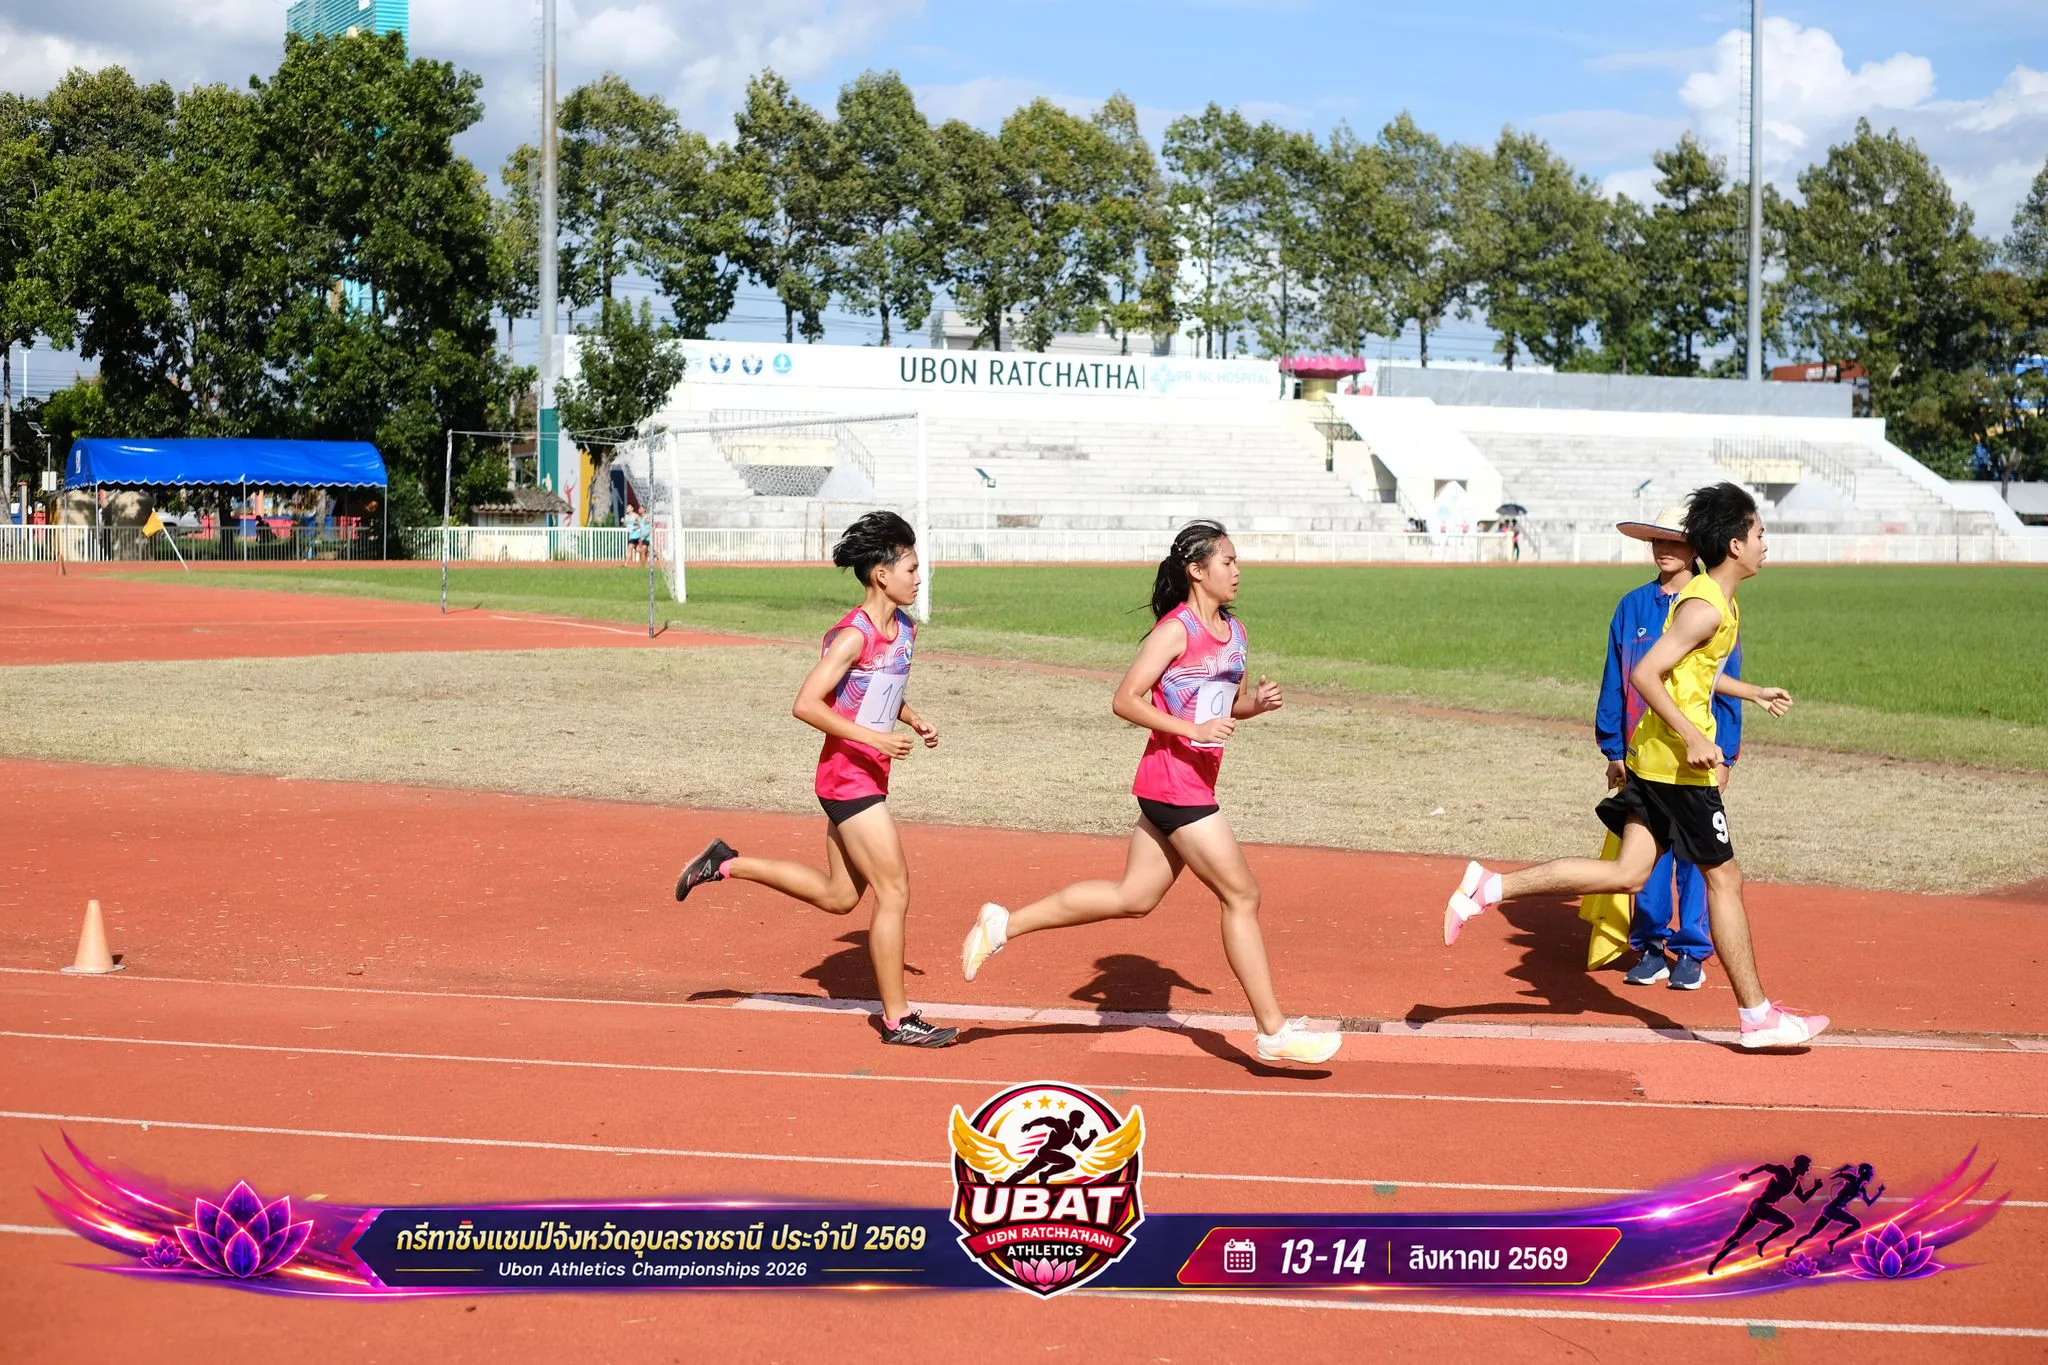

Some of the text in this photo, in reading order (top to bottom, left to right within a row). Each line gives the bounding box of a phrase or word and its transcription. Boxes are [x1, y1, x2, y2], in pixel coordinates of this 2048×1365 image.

[900, 356, 977, 385] UBON
[1217, 372, 1271, 385] HOSPITAL
[1712, 811, 1729, 844] 9
